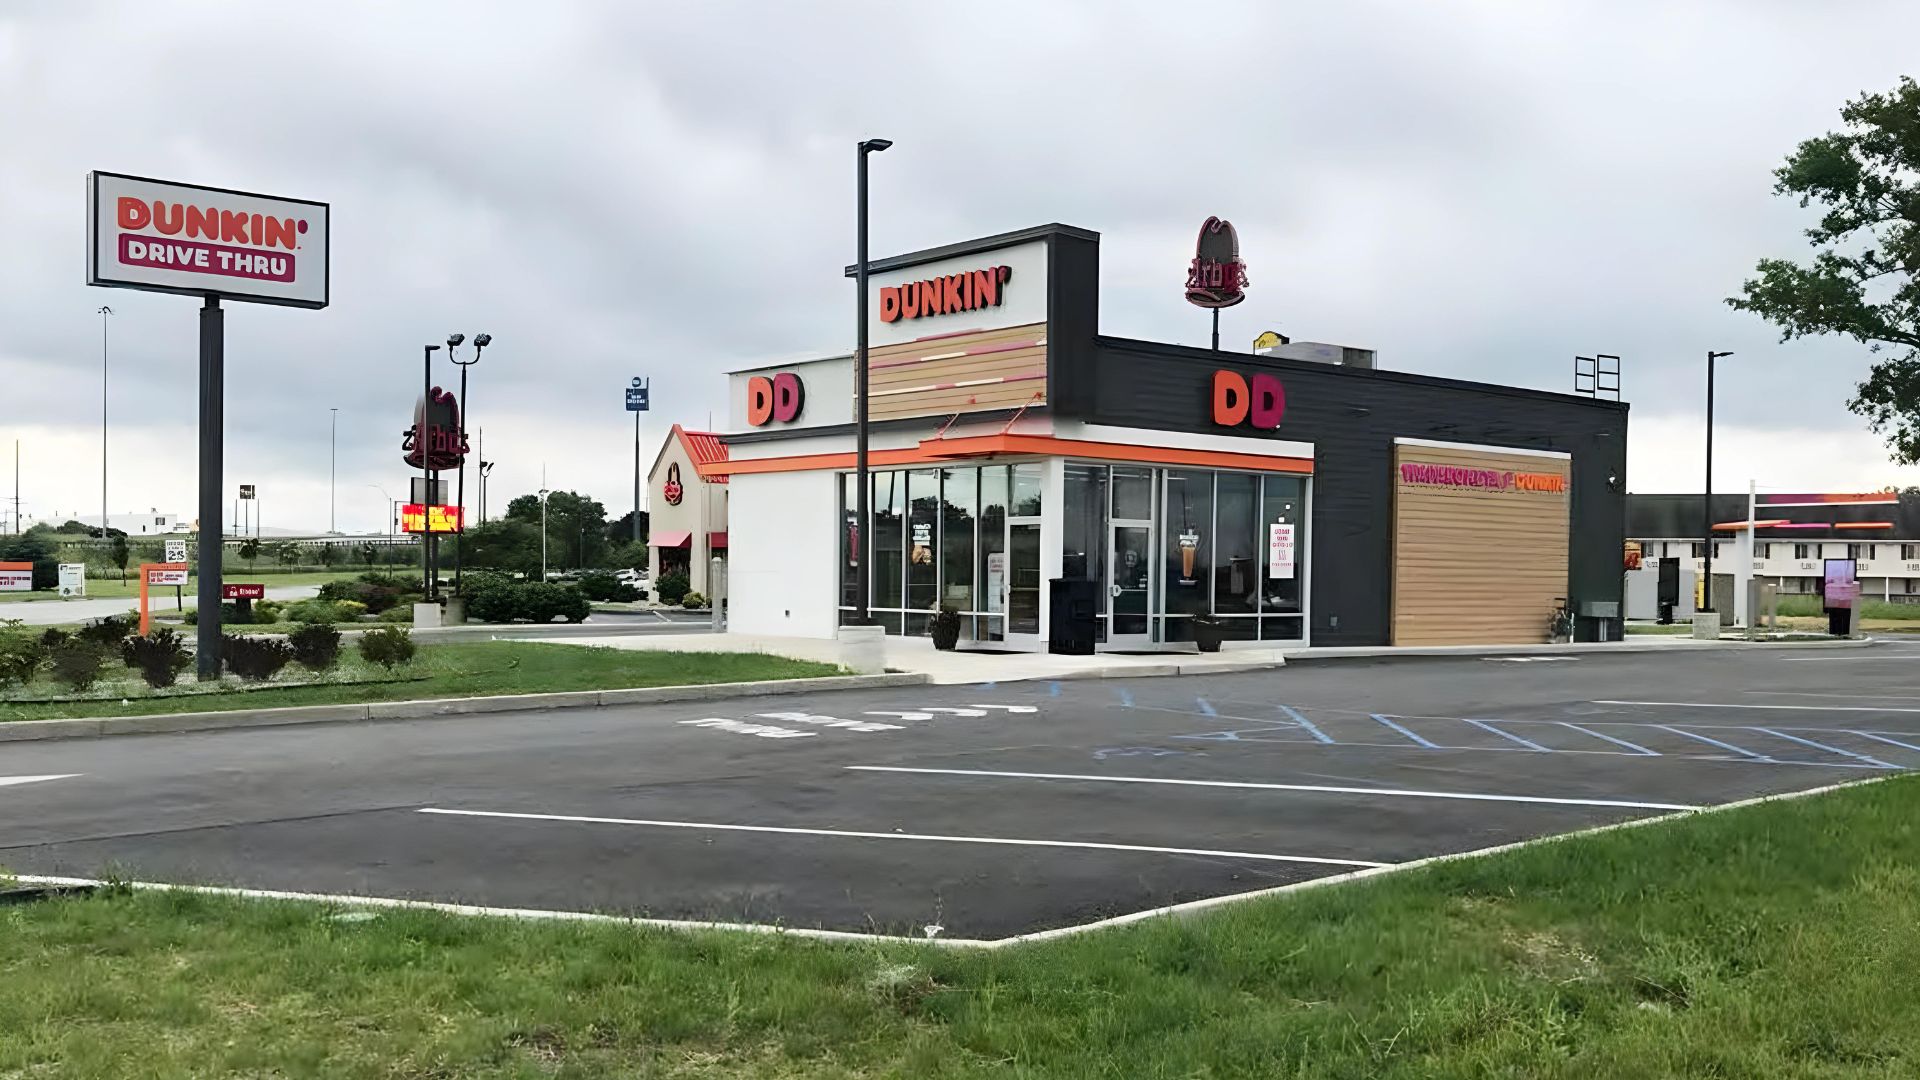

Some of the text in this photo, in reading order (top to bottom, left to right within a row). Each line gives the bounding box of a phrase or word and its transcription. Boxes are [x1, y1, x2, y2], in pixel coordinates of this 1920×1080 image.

[117, 196, 308, 249] DUNKIN'
[128, 240, 287, 276] DRIVE THRU
[880, 265, 1012, 323] DUNKIN'
[747, 372, 805, 426] DD
[1210, 369, 1286, 429] DD
